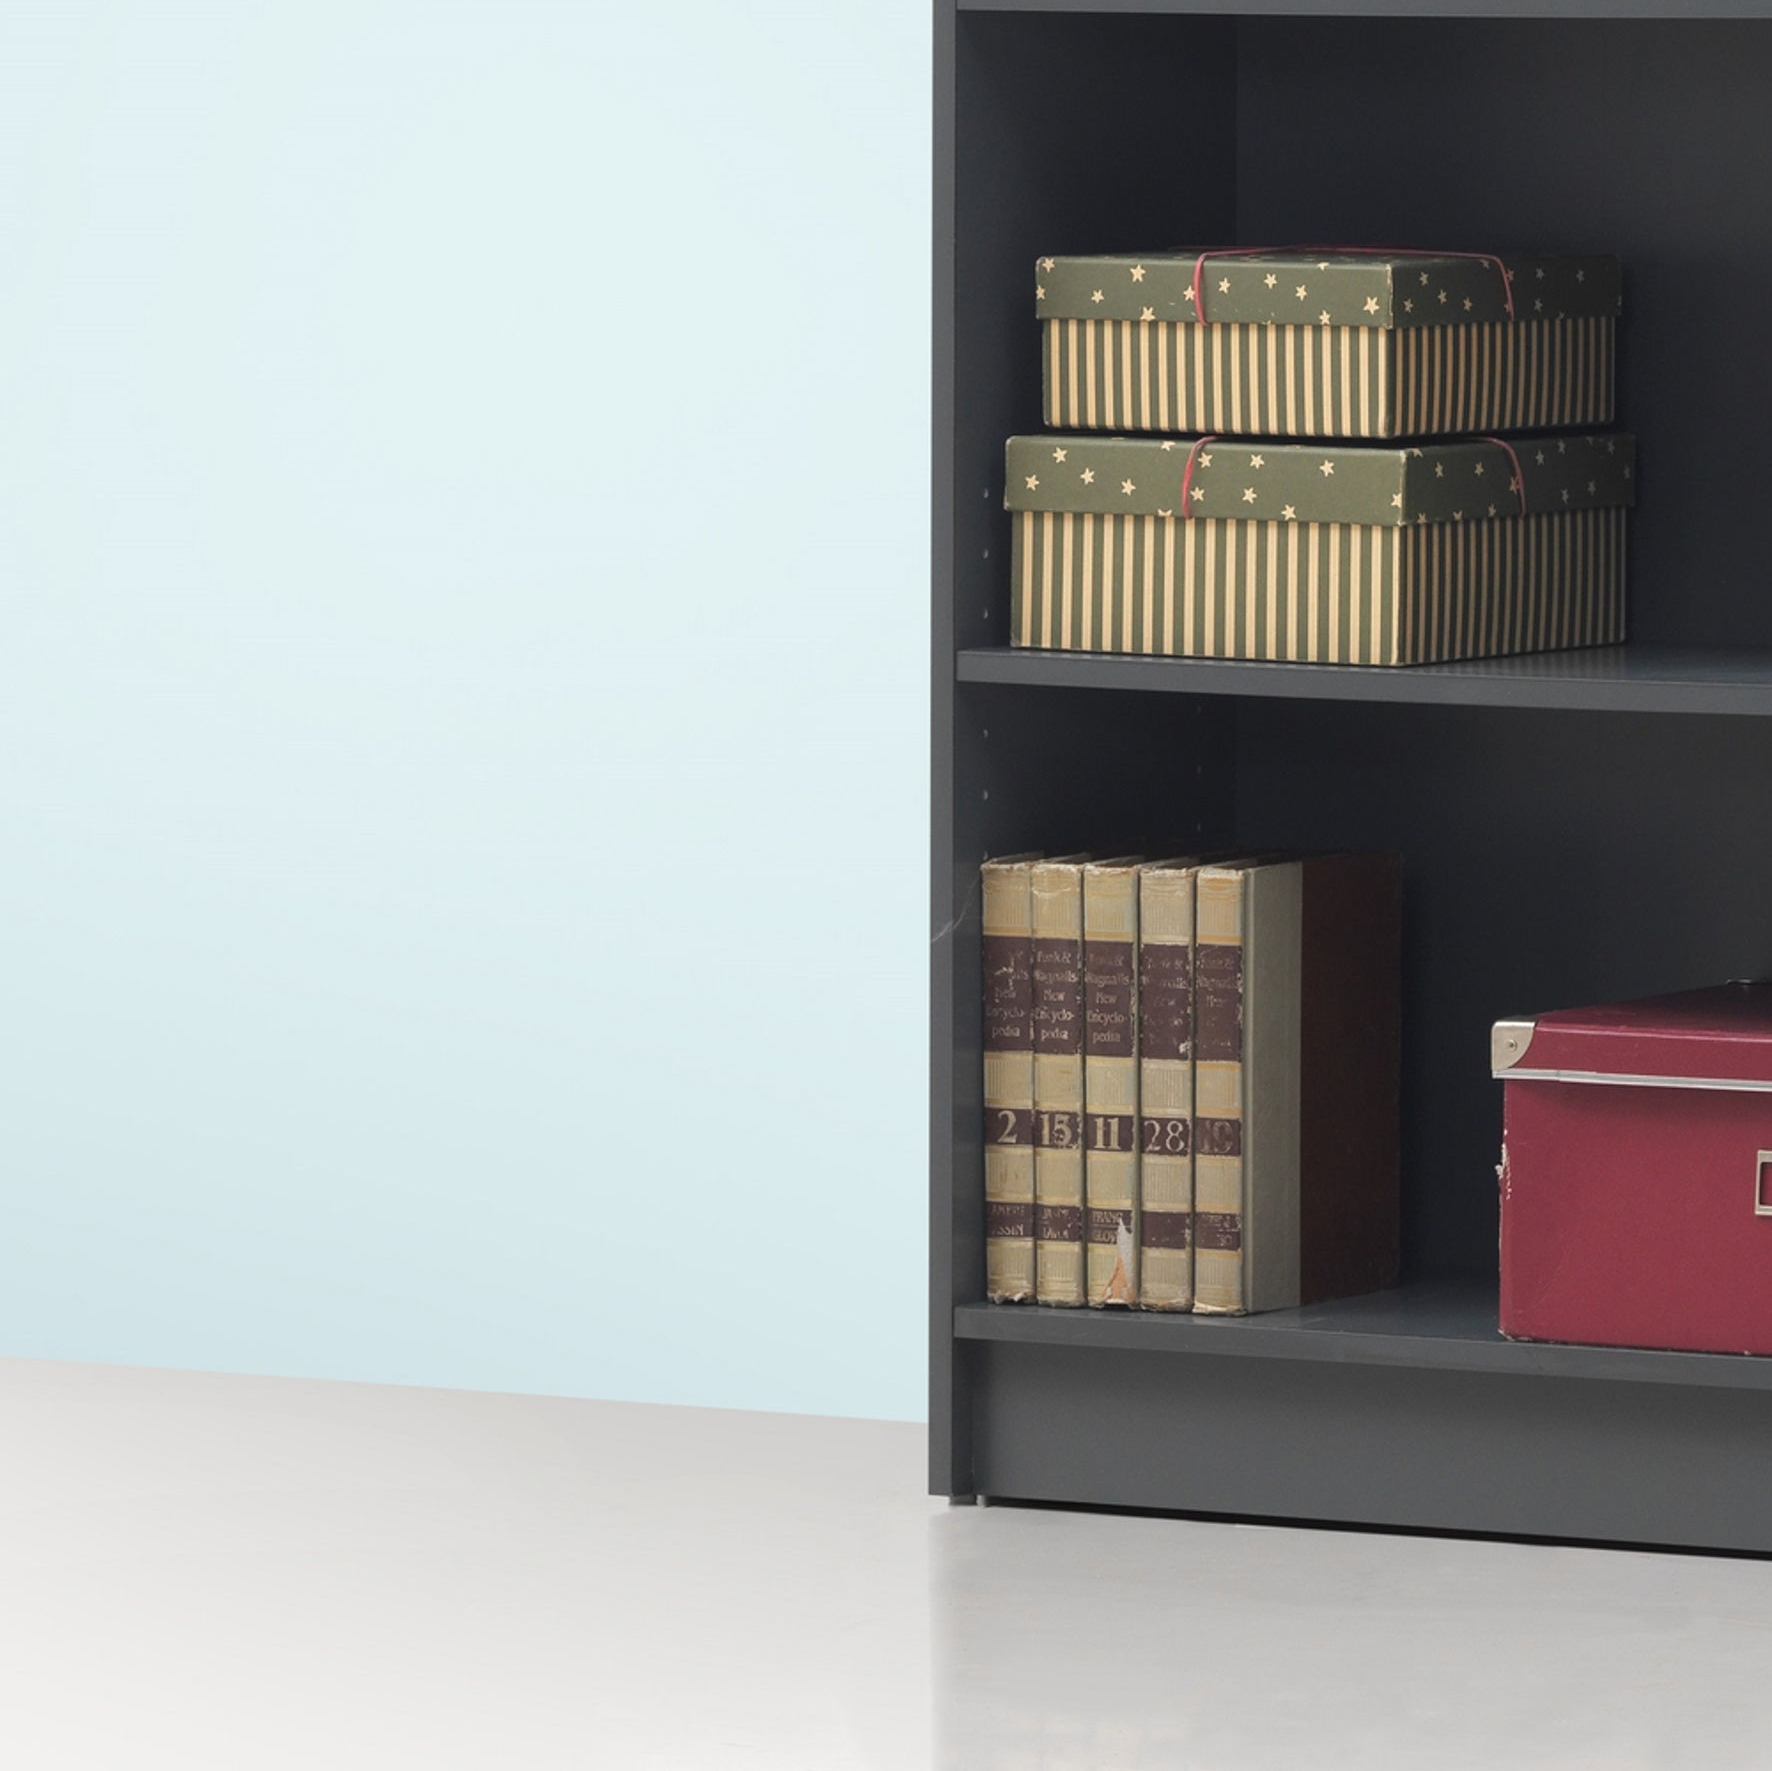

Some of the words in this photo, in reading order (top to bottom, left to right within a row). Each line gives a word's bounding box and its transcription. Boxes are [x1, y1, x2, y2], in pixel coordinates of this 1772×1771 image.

[997, 1109, 1017, 1144] 2
[1040, 1112, 1073, 1147] 15
[1094, 1116, 1122, 1151] 11
[1143, 1119, 1185, 1153] 28
